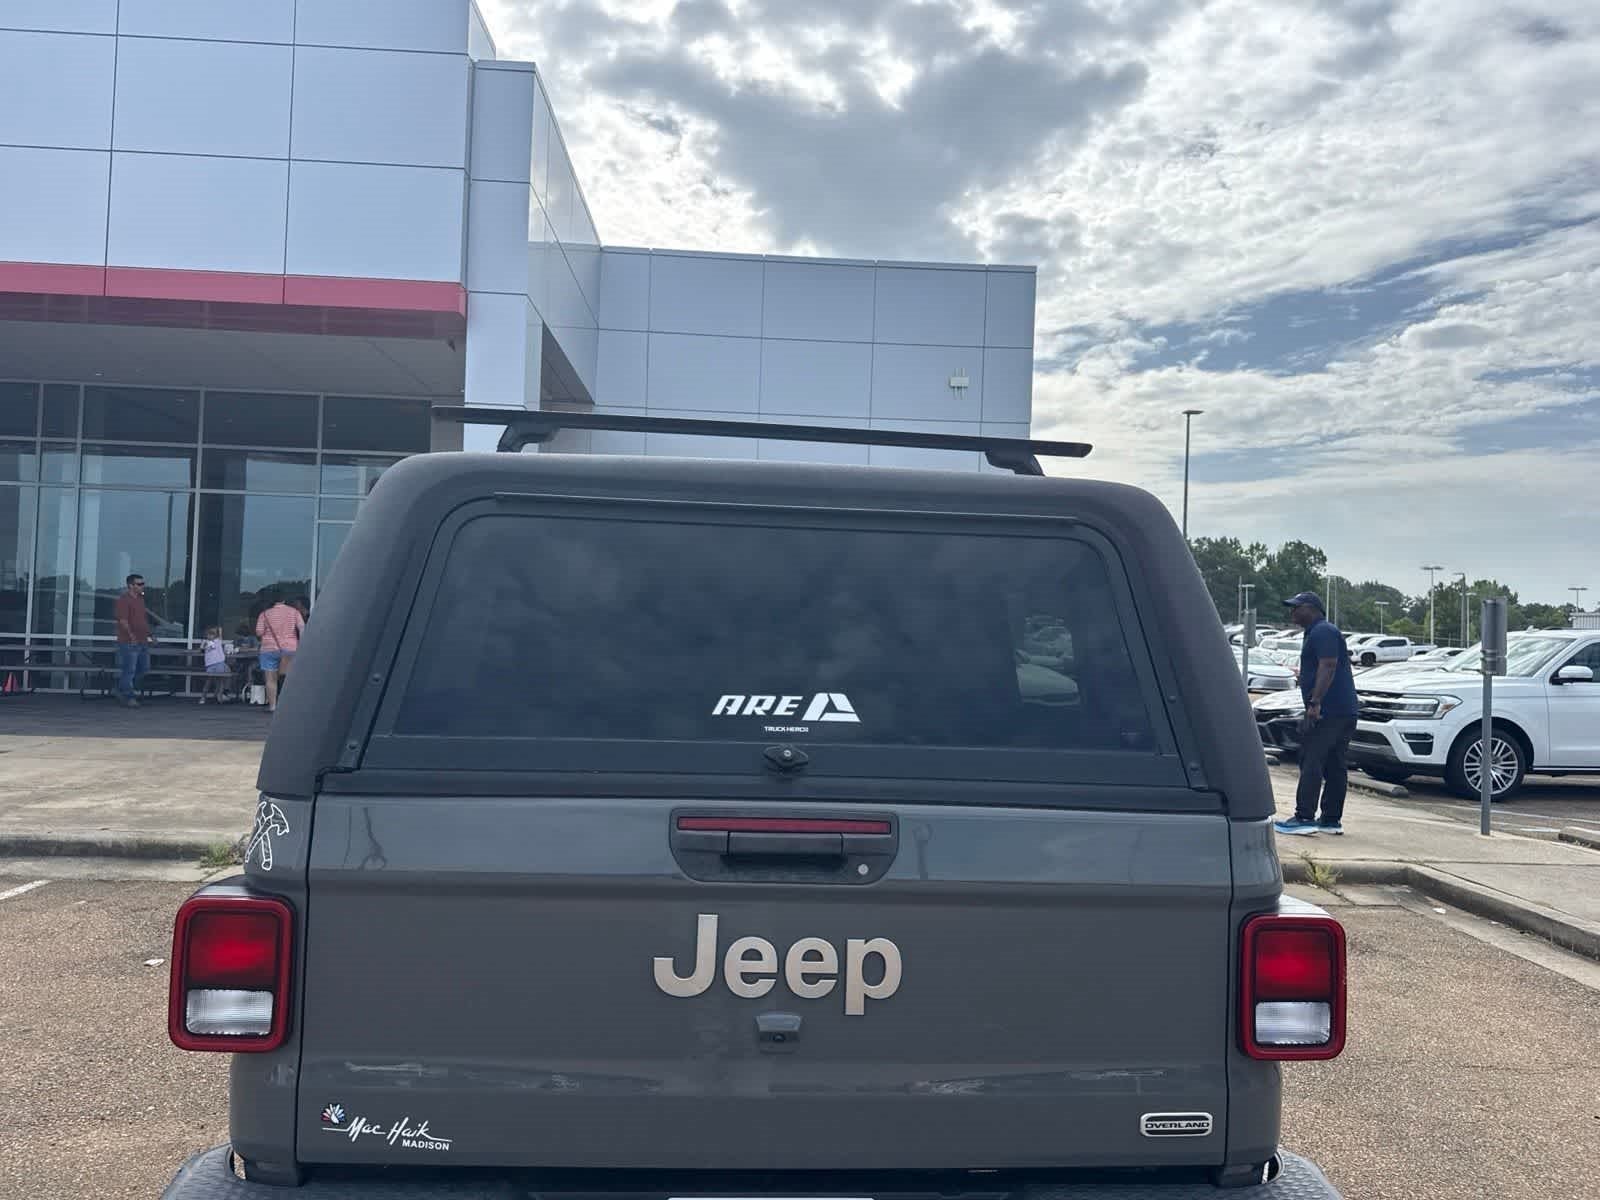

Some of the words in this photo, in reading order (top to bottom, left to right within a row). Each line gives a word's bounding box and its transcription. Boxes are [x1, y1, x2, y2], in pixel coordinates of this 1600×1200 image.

[711, 694, 803, 715] ARE
[653, 913, 902, 1016] Jeep
[334, 1116, 386, 1142] Mac
[386, 1116, 448, 1146] Haik
[1144, 1120, 1210, 1129] OVERLAND
[402, 1138, 450, 1151] MADISON
